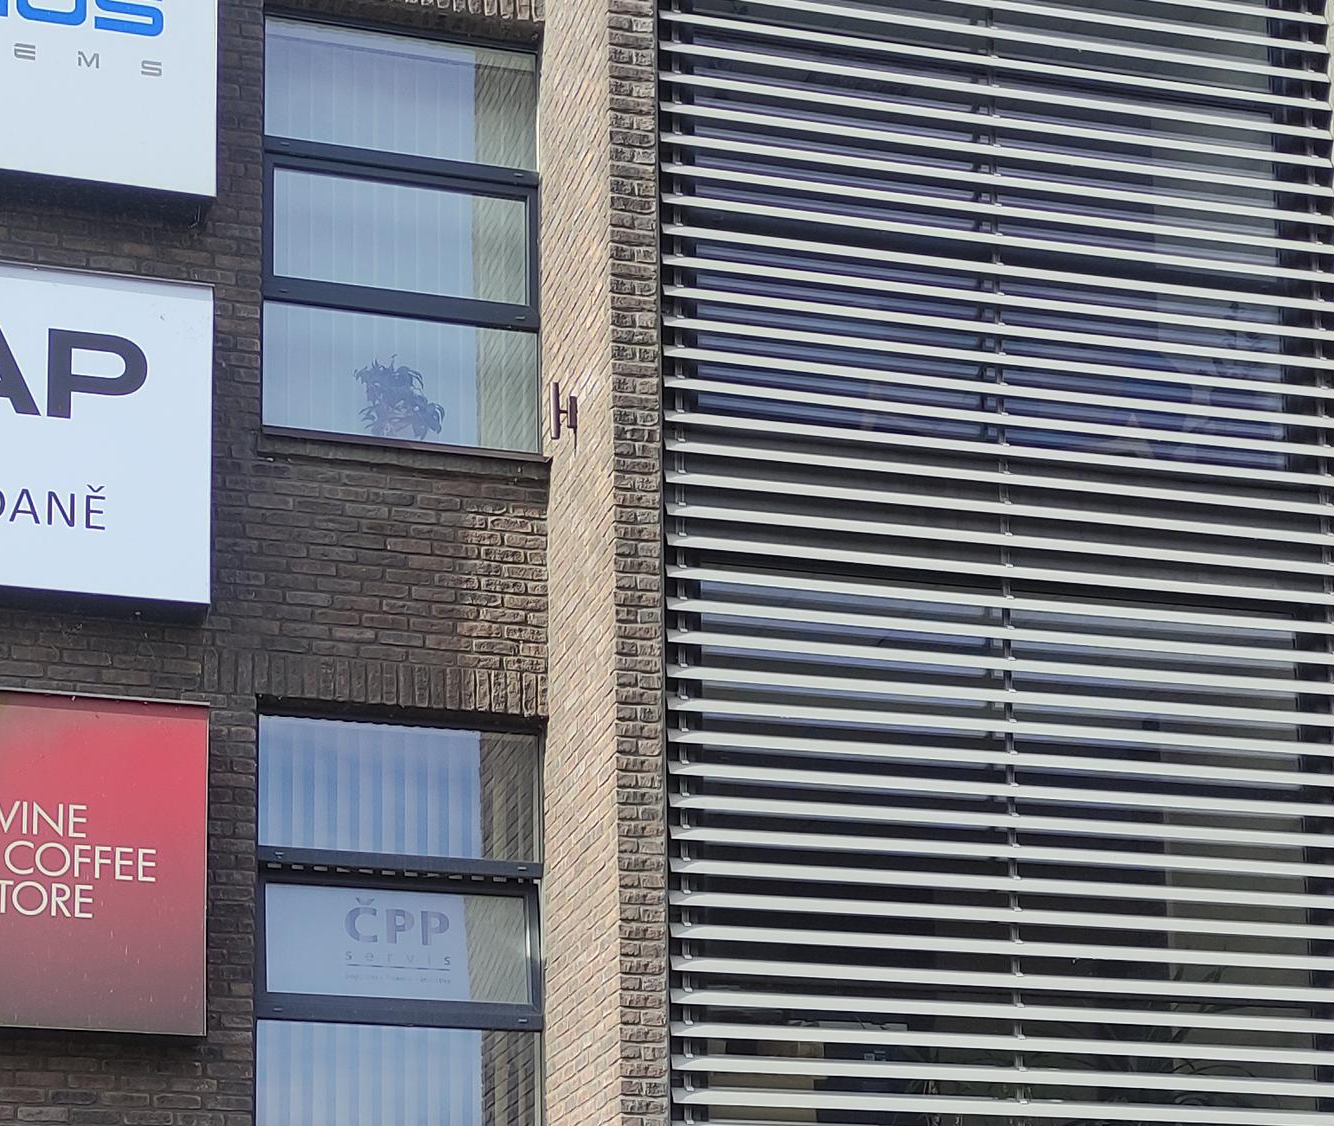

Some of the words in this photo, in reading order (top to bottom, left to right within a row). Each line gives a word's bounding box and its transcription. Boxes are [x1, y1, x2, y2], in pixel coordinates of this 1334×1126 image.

[4, 841, 157, 883] COFFEE
[345, 897, 450, 946] ČPP
[345, 951, 451, 966] servis
